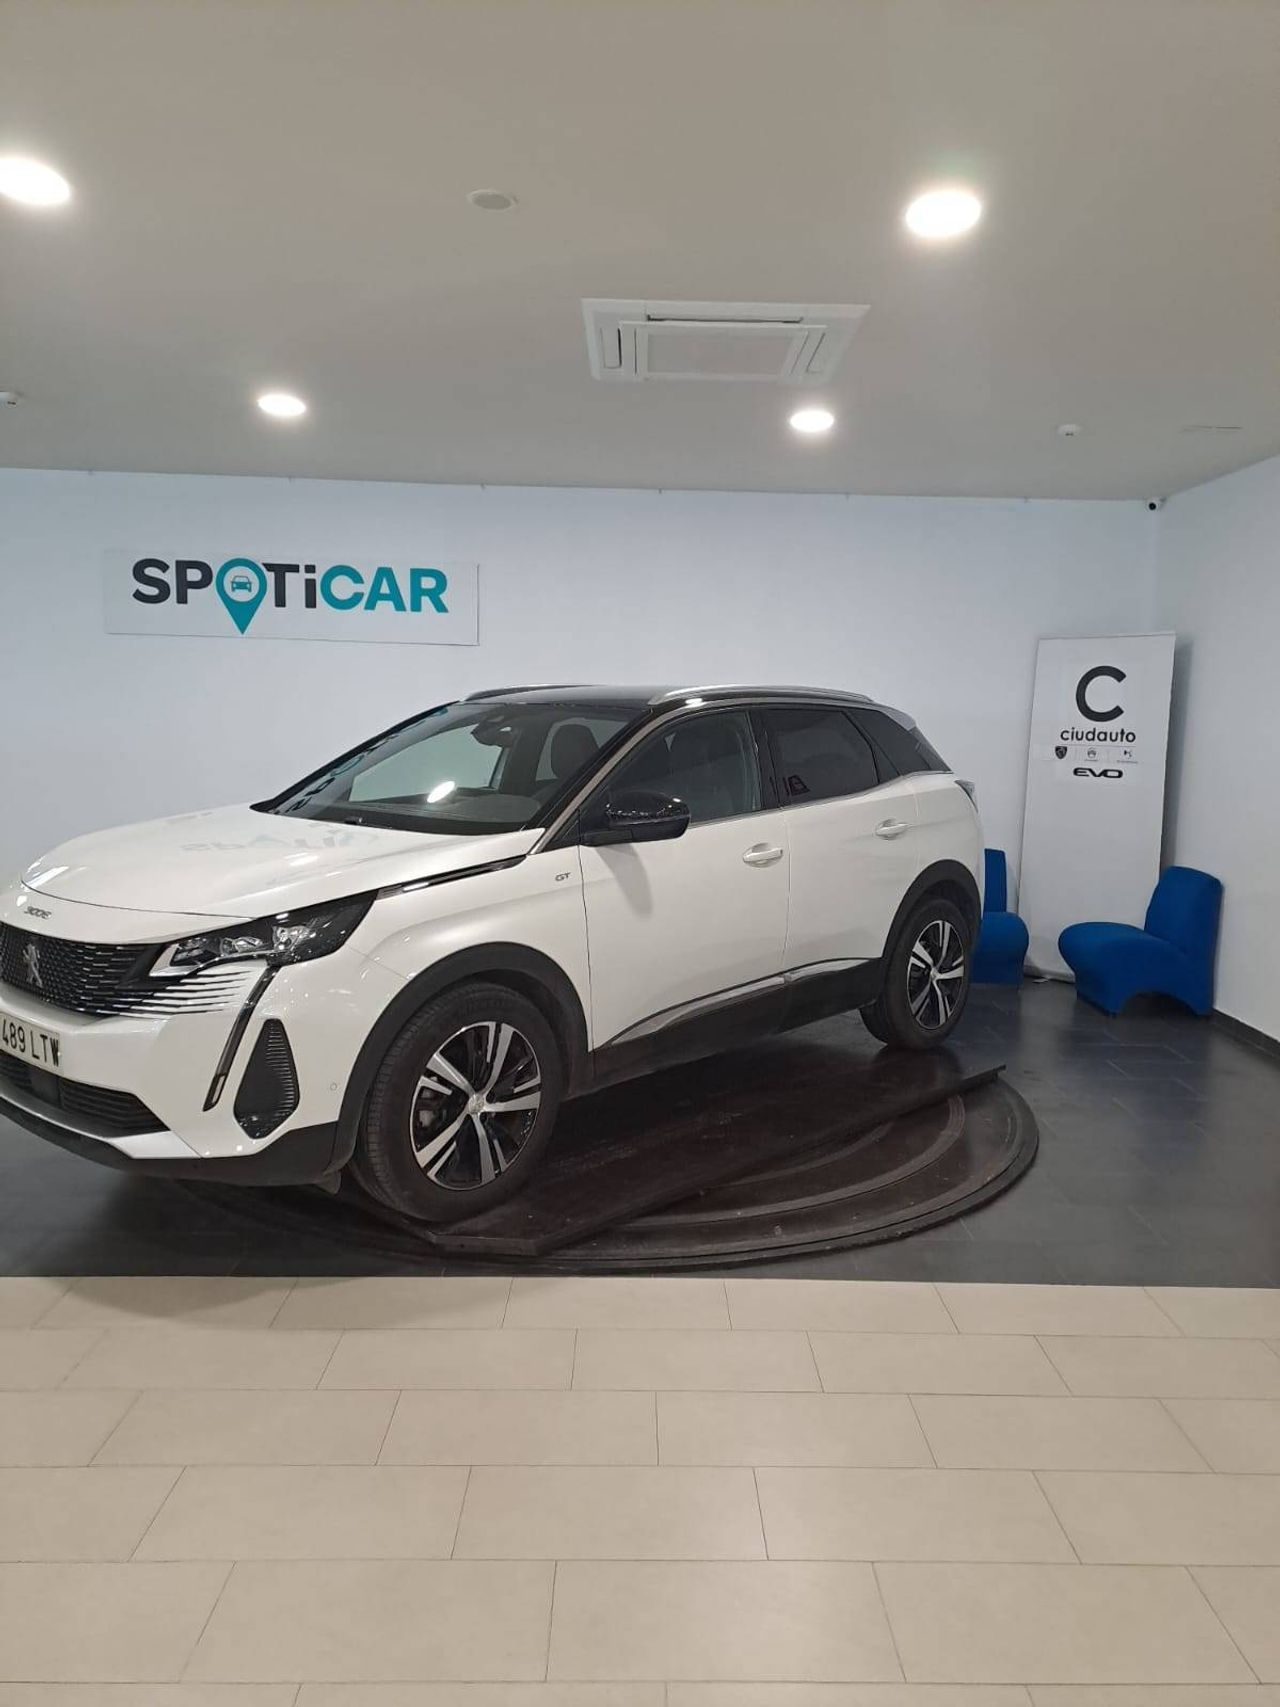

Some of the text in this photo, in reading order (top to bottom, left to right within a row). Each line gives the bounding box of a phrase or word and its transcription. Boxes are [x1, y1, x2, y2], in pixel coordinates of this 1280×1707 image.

[1060, 727, 1136, 743] ciudauto
[1073, 767, 1123, 778] EVO
[555, 872, 571, 881] GT
[30, 1030, 59, 1067] LTW
